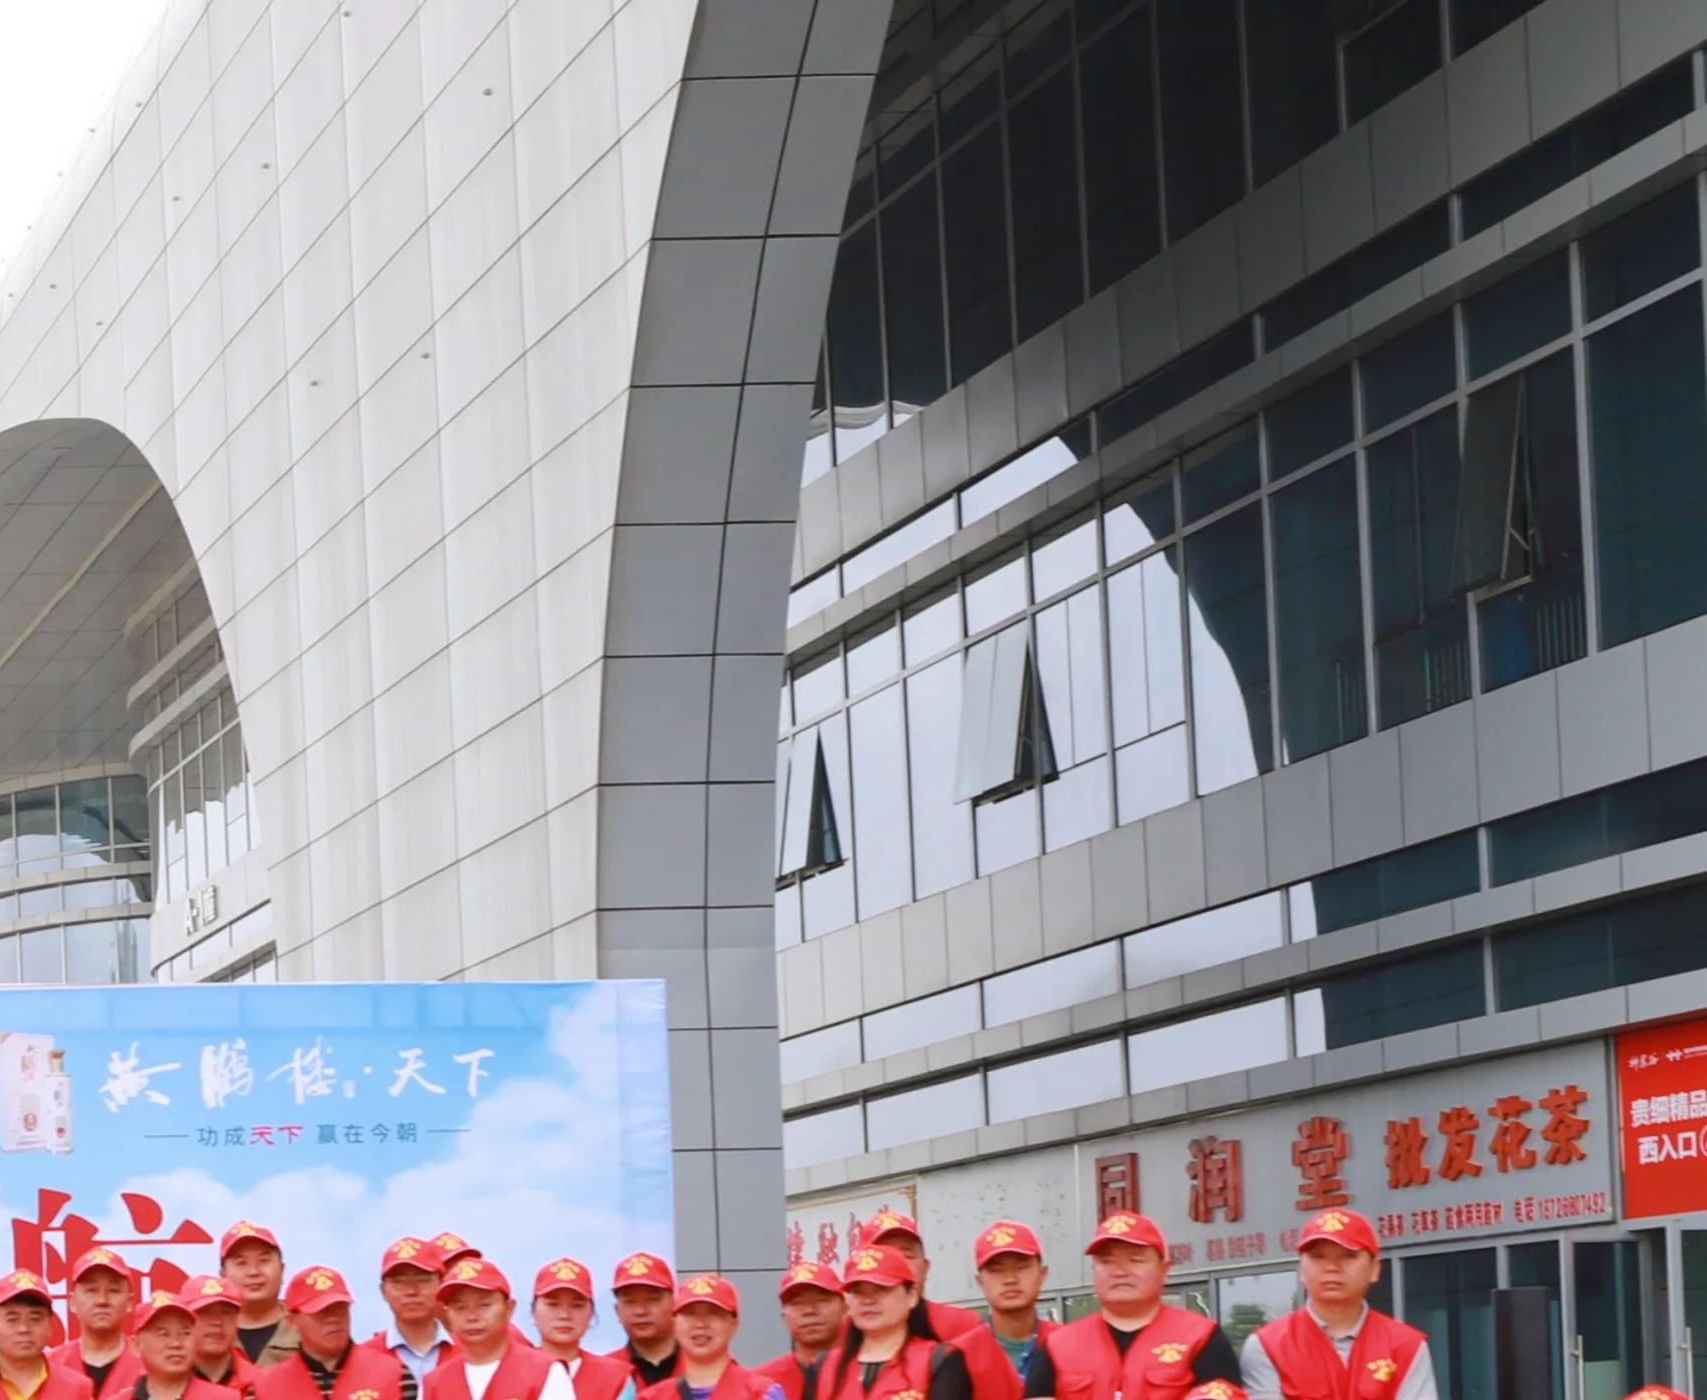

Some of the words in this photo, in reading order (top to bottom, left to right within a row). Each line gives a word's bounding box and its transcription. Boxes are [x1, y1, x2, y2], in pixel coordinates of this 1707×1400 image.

[197, 1124, 304, 1147] 功成天下
[317, 1121, 419, 1145] 赢在今朝
[1095, 1114, 1352, 1223] 同润堂
[1384, 1085, 1590, 1189] 批发花茶
